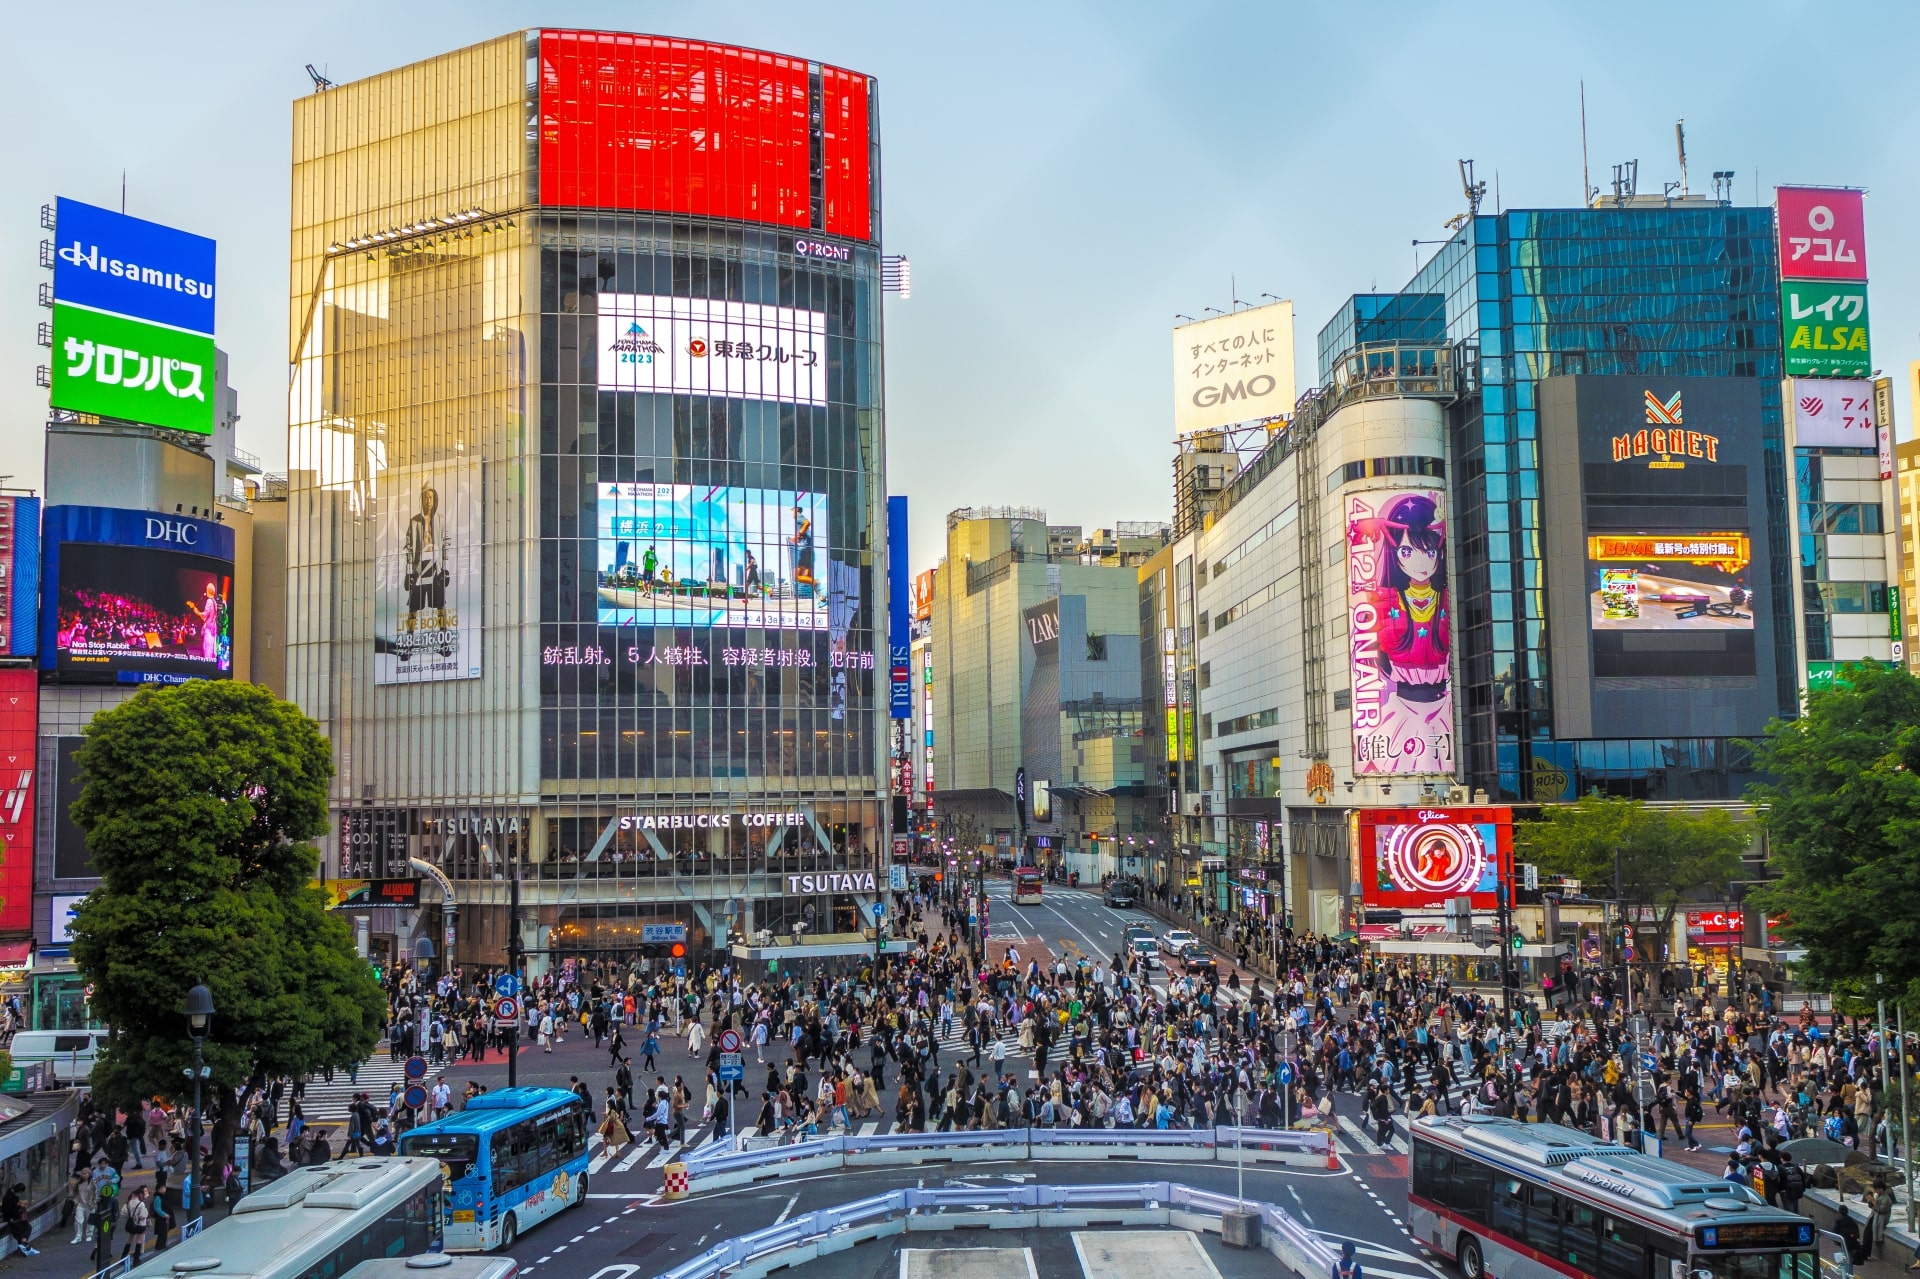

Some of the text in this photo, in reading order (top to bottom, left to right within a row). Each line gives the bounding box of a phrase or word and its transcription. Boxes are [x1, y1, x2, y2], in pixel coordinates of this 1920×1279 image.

[1789, 237, 1857, 262] アコム
[59, 241, 213, 299] Hisamitsu
[1790, 293, 1864, 321] レイク
[1190, 328, 1275, 359] すべての人に
[1790, 325, 1868, 351] ALSA
[620, 352, 653, 364] 2023
[714, 339, 818, 367] 東急グループ
[1192, 348, 1275, 378] インターネット
[63, 337, 205, 403] サロンパス
[1192, 374, 1276, 408] GMO
[1841, 397, 1870, 412] アイ
[1842, 416, 1872, 430] フル
[1612, 429, 1719, 463] MAGNET
[145, 518, 198, 545] DHC
[1655, 541, 1735, 556] 最新号の特別付録は
[1029, 613, 1059, 644] ZARA
[88, 641, 106, 650] Stop
[106, 642, 130, 650] Rabbit
[143, 674, 163, 682] DHC
[892, 645, 909, 708] SEIBU
[1808, 670, 1833, 680] レイク
[1355, 734, 1452, 763] 【推しの子】
[1017, 772, 1025, 801] ZARA
[434, 817, 519, 835] TSUTAYA
[620, 812, 804, 830] STARBUCKS COFFEE
[1418, 811, 1449, 823] Glico
[895, 842, 906, 853] 本
[787, 872, 877, 895] TSUTAYA
[645, 926, 683, 936] 渋谷駅前
[1580, 1171, 1636, 1199] Hybrid
